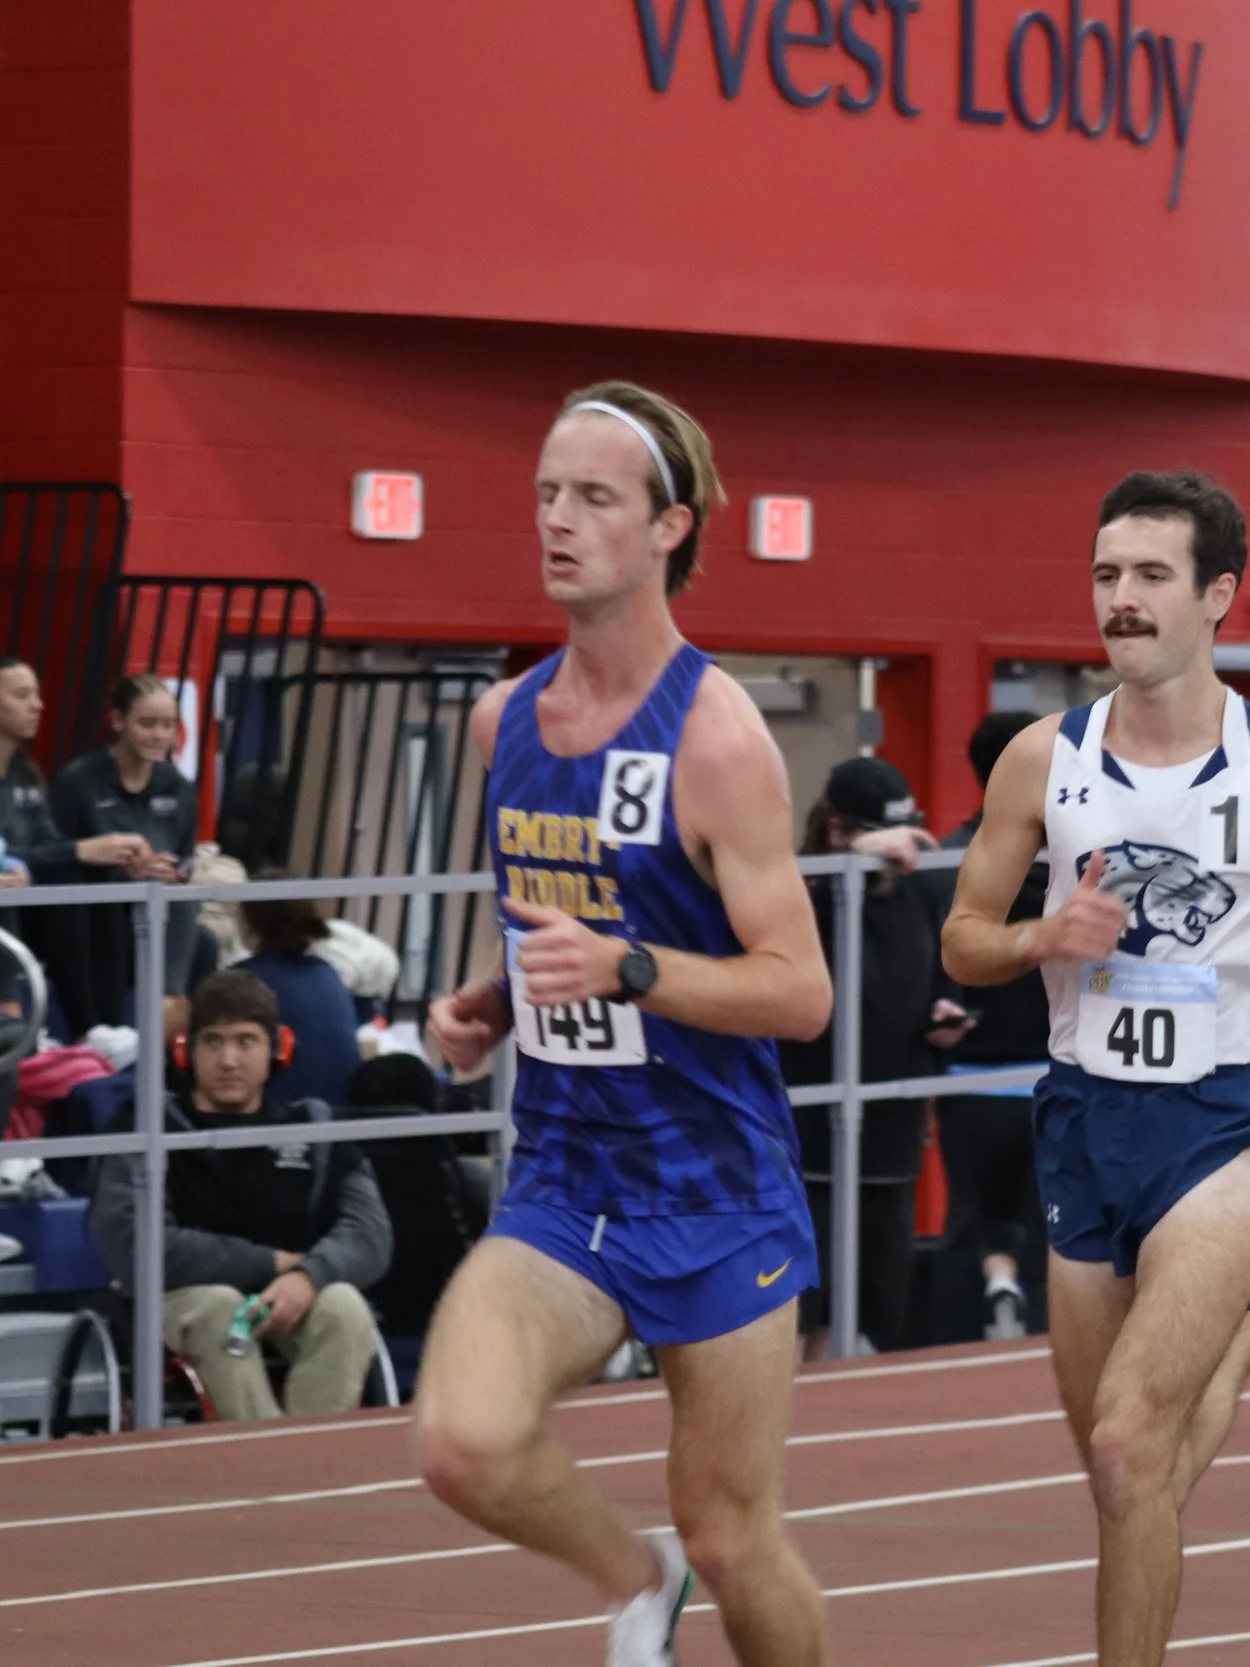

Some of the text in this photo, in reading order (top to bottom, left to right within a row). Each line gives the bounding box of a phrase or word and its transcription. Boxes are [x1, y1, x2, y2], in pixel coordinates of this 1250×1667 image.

[634, 0, 1204, 210] West Lobby
[611, 759, 654, 834] 8
[1210, 795, 1238, 864] 1
[534, 998, 615, 1050] 149
[1107, 1006, 1175, 1068] 40
